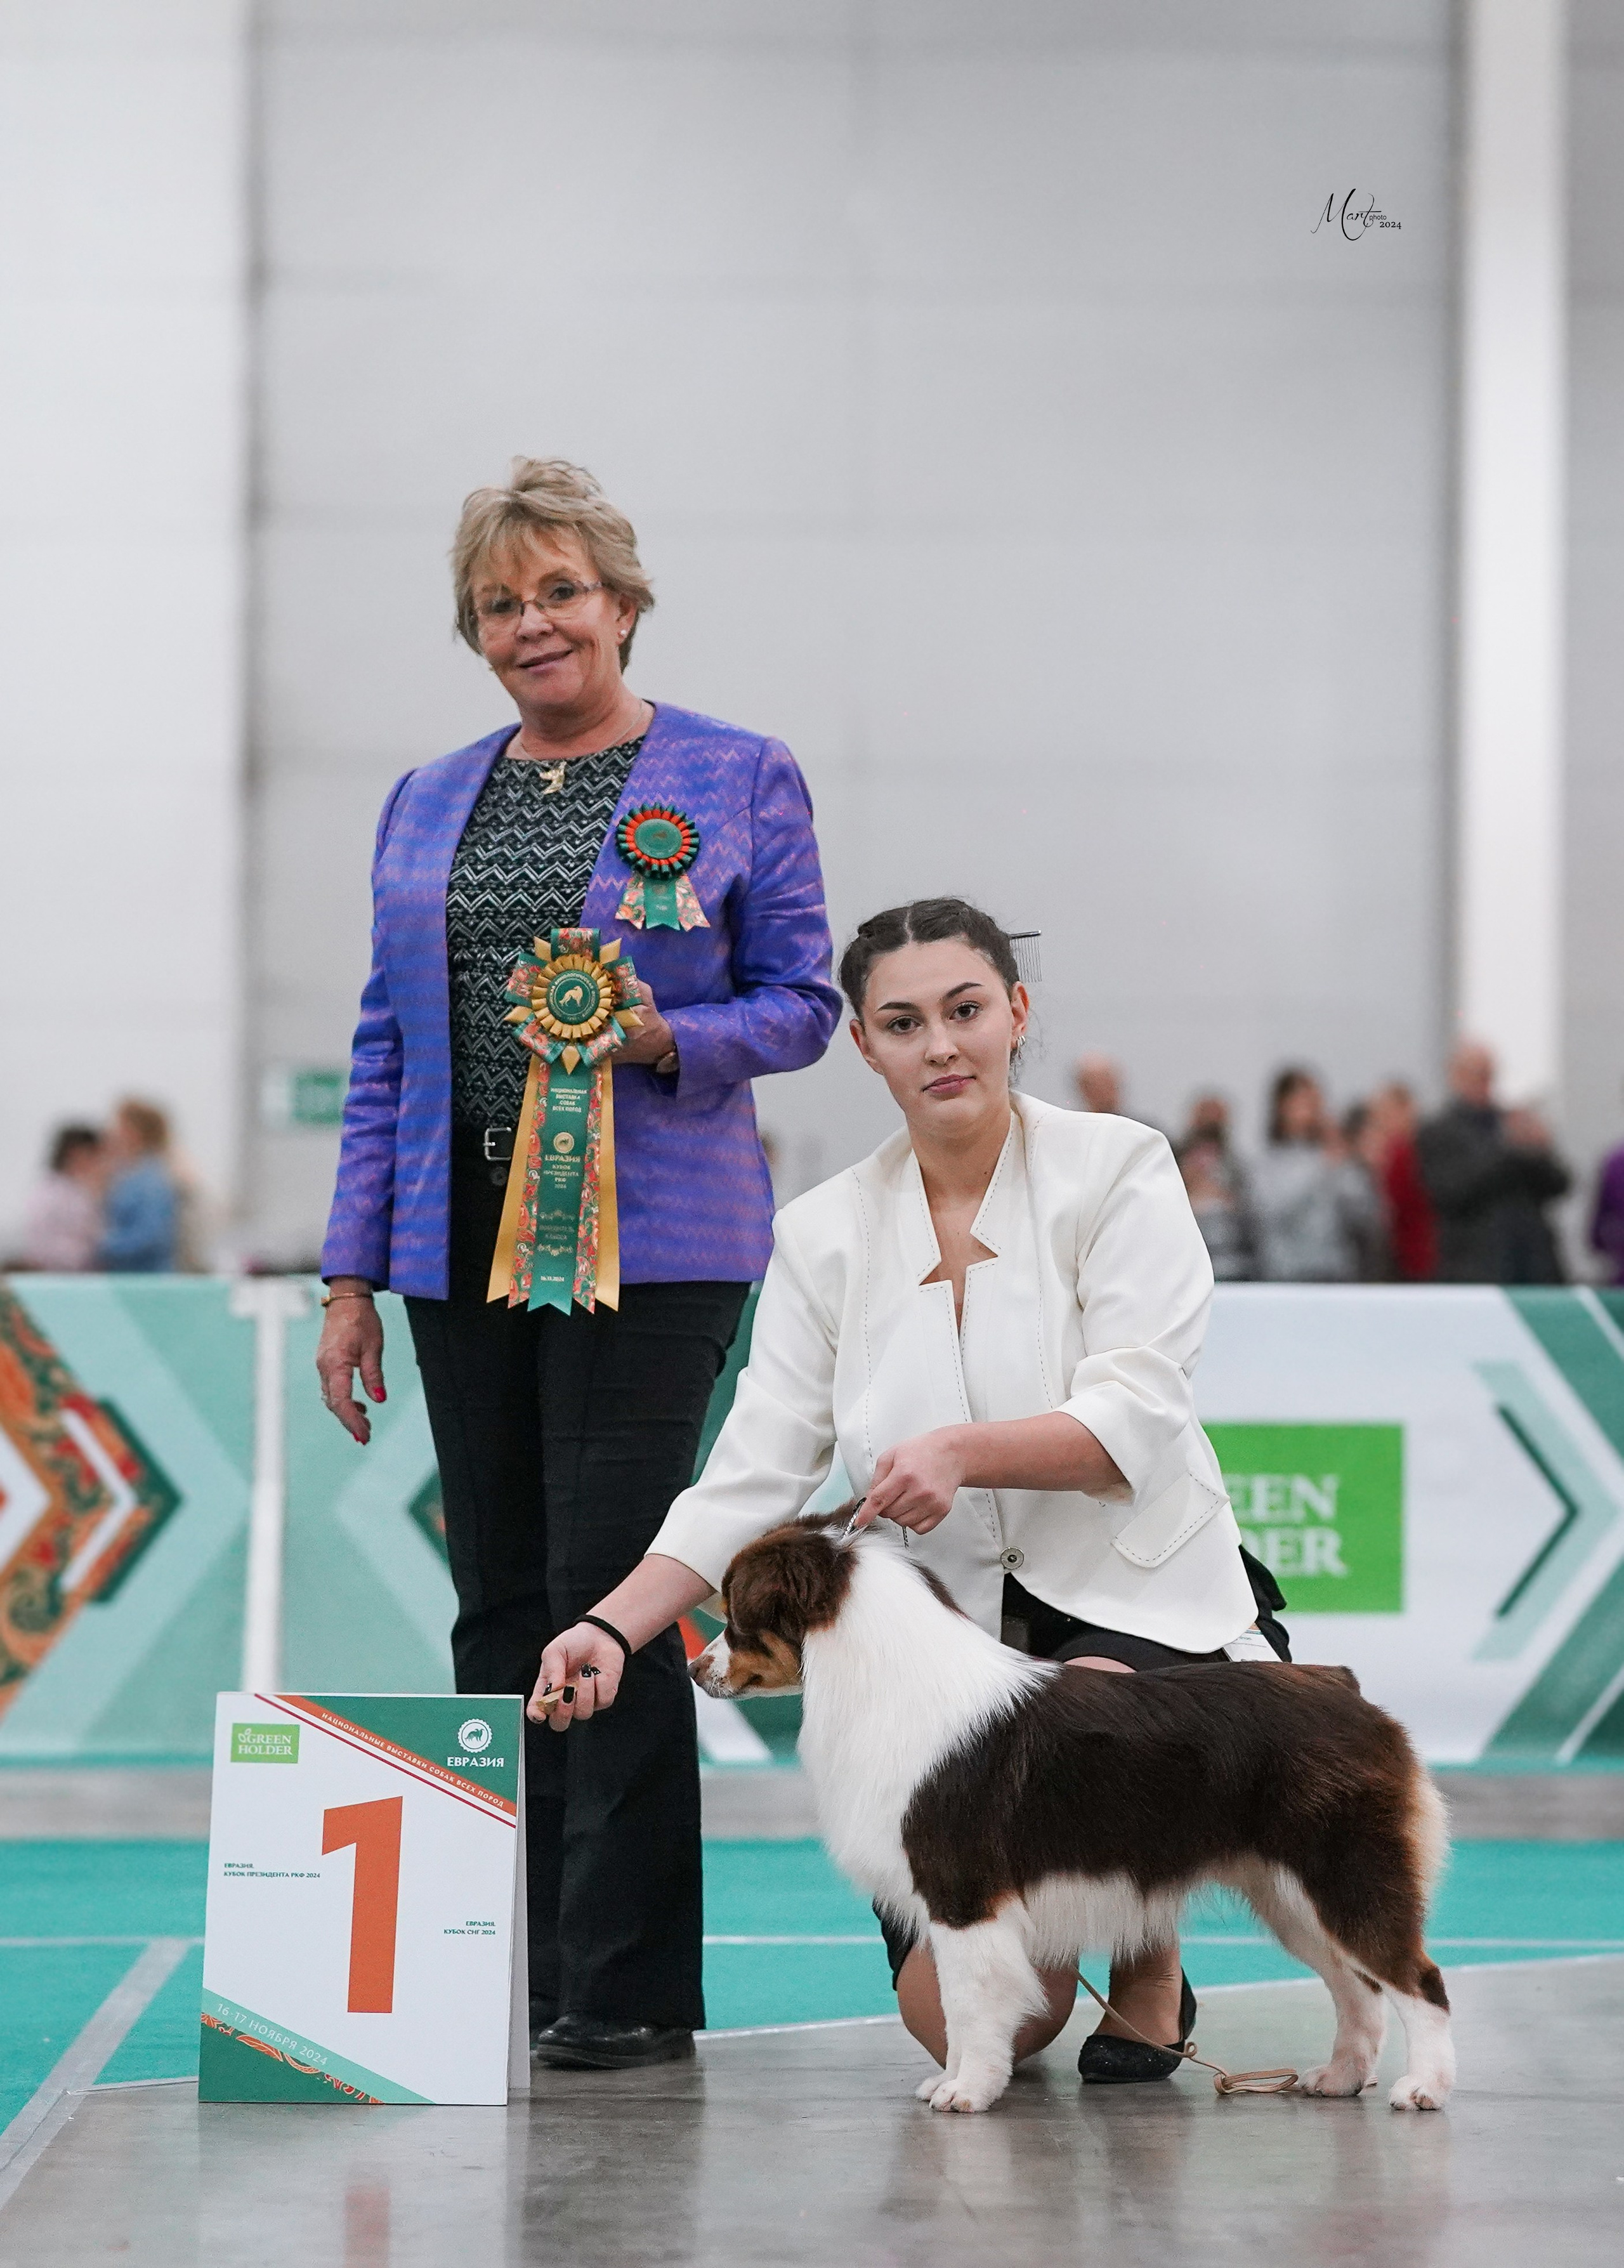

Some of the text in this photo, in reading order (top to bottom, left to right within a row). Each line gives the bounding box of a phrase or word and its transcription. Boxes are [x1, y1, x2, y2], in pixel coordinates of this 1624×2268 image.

[238, 1744, 293, 1755] HOLDER
[247, 1733, 292, 1745] GREEN
[322, 1713, 505, 1809] НАЦИОНАЛЬНЫЕ ВЫСТАВКИ СОБАК ВСЕХ ПОРОД
[447, 1756, 505, 1768] ЕВРАЗИЯ
[322, 1796, 403, 2013] 1
[217, 2003, 329, 2066] 16-17 НОЯБРЯ 2024
